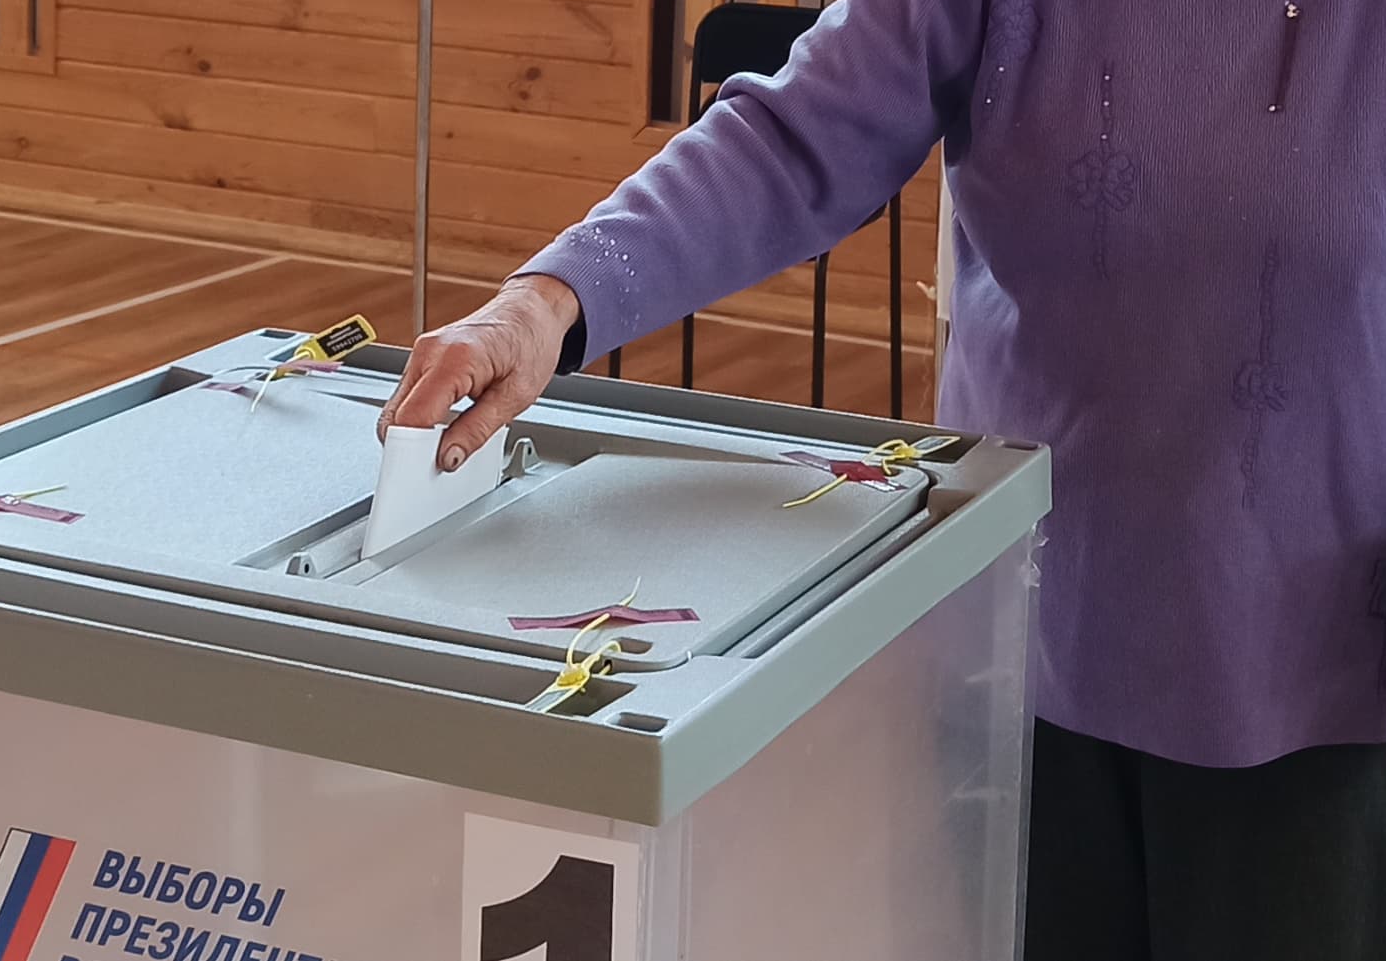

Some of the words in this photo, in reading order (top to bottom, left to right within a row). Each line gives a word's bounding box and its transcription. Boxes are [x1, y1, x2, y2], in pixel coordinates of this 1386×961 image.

[93, 849, 286, 927] ВЫБОРЫ
[480, 854, 614, 961] 1
[70, 902, 337, 961] ПРЕЗИДЕ
